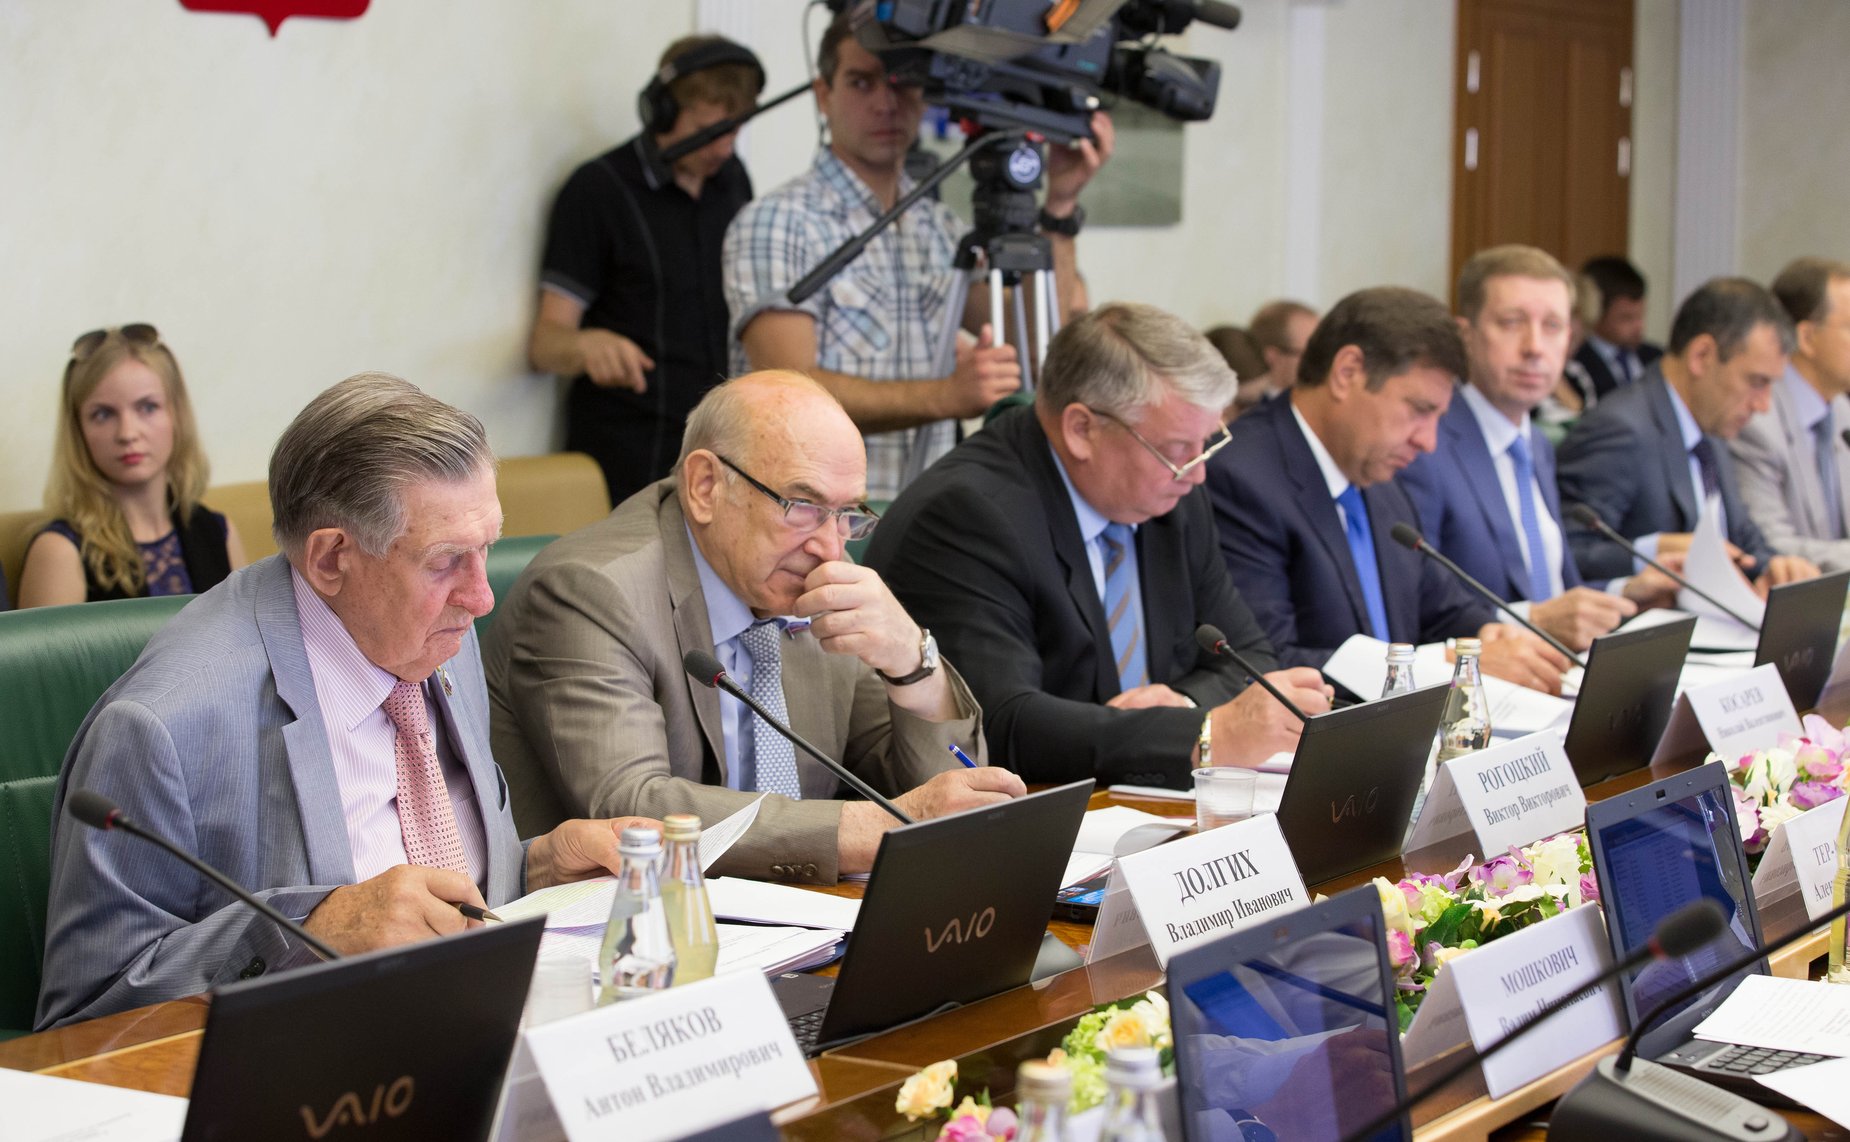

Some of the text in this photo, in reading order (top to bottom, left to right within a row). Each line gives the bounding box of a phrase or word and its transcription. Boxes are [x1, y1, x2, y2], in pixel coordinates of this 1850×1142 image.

[1477, 745, 1552, 794] РОГОЦКИЙ
[1331, 786, 1379, 824] VAIO
[1483, 801, 1521, 826] Виктор
[1519, 784, 1573, 813] Викторович
[1172, 848, 1261, 907] ДОЛГИХ
[1812, 839, 1837, 867] ТЕР-
[924, 906, 996, 953] VAIO
[1166, 906, 1235, 944] Владимир
[1232, 887, 1295, 920] Иванович
[1500, 945, 1579, 998] МОШКОВИЧ
[605, 1006, 723, 1064] БЕЛЯКОВ
[300, 1075, 415, 1139] VAIO
[583, 1040, 784, 1121] Антон Владимирович
